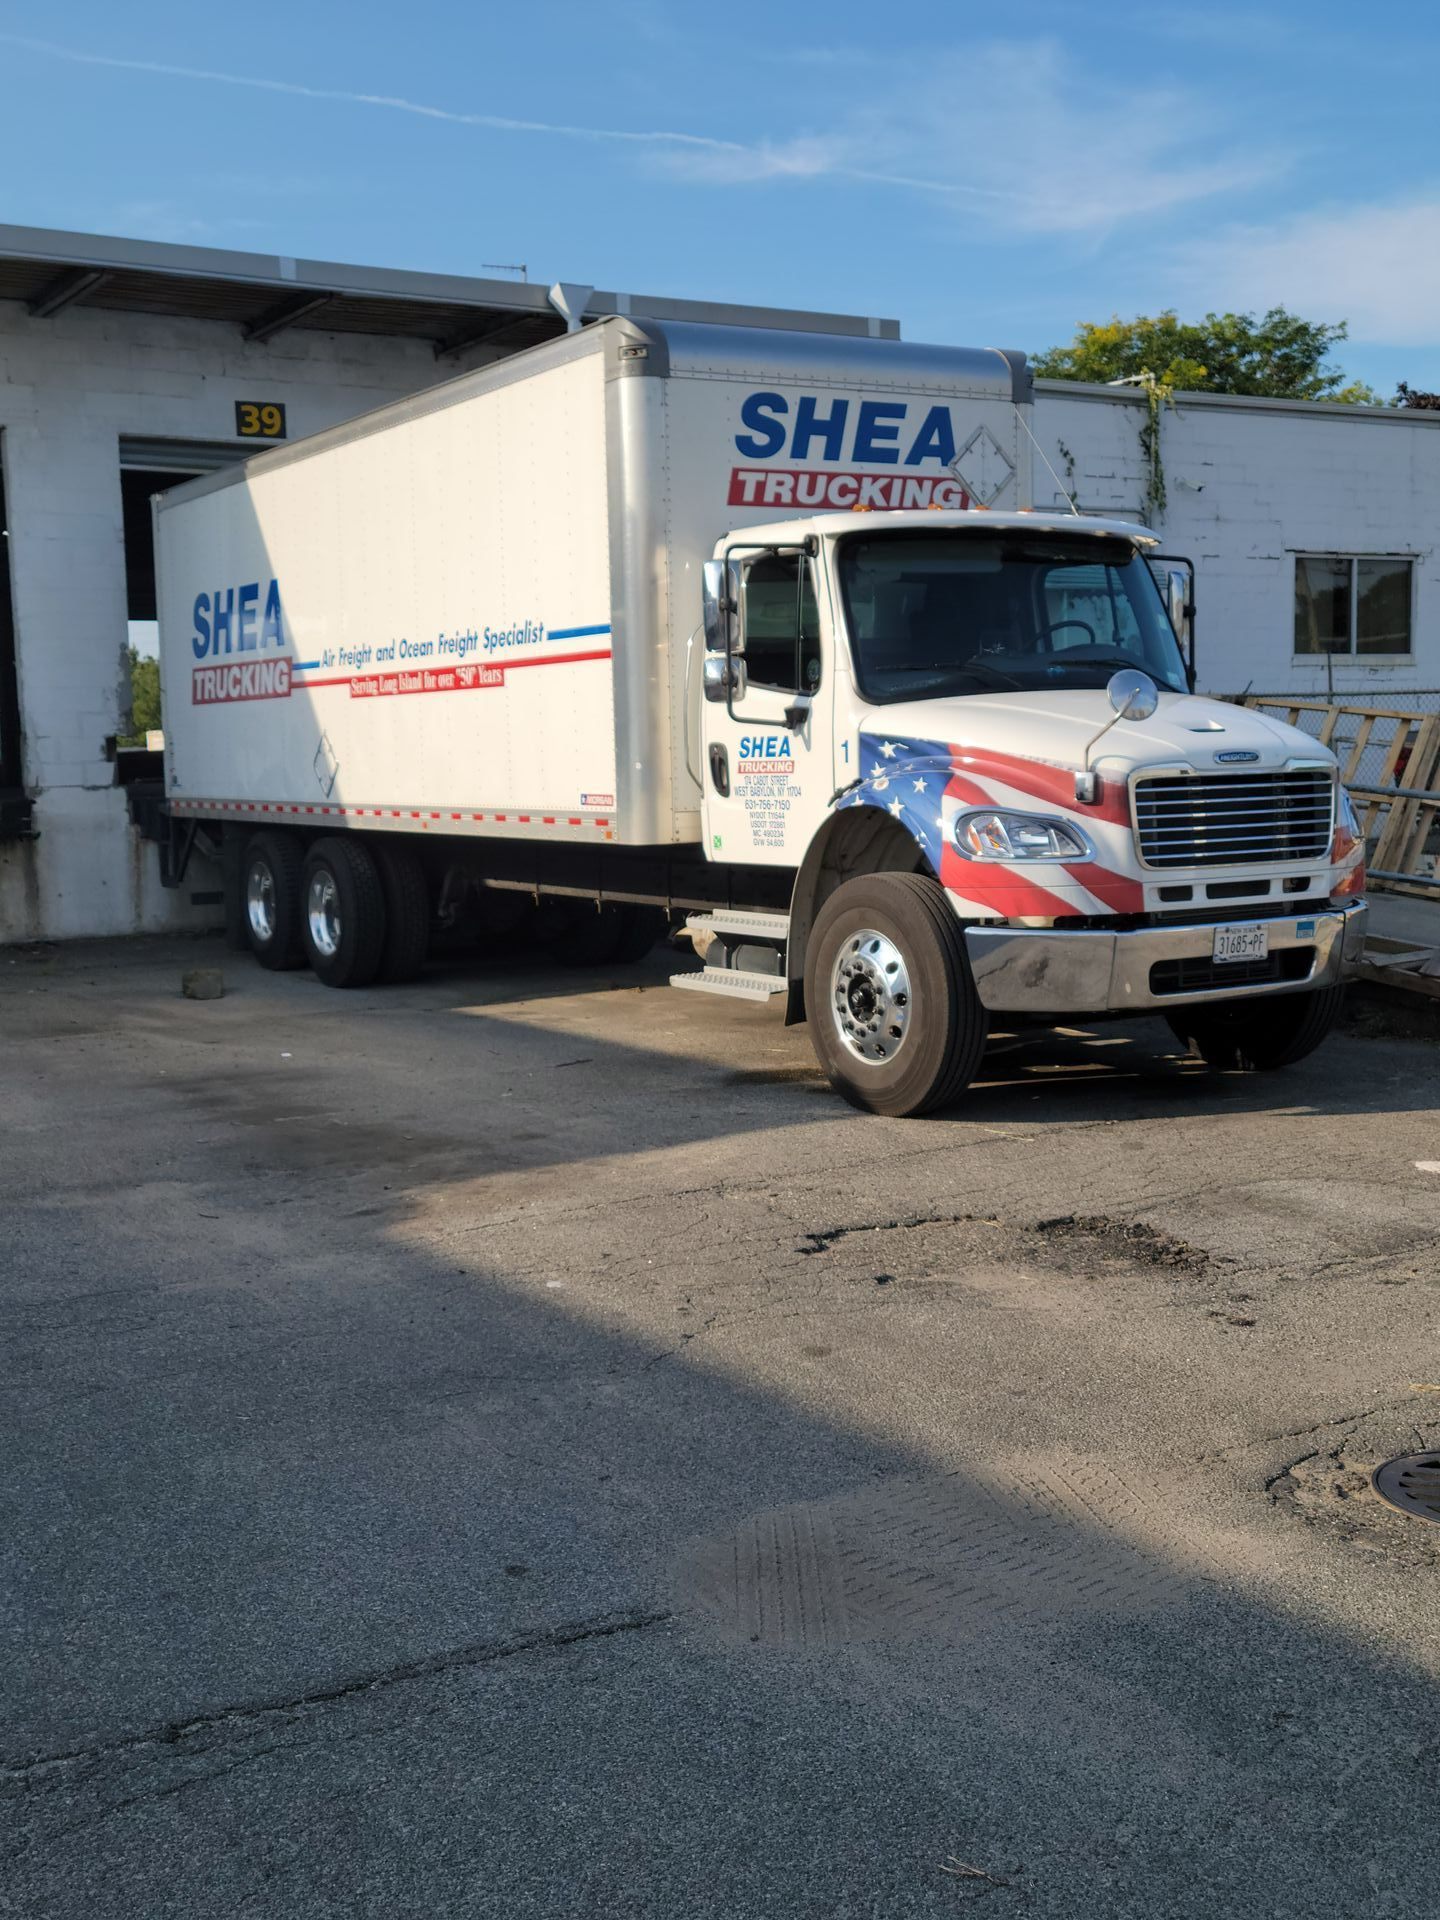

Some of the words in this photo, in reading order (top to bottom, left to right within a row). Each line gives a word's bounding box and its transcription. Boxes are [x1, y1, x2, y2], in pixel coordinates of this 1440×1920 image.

[241, 405, 281, 435] 39
[735, 392, 956, 467] SHEA
[737, 471, 961, 509] TRUCKING
[192, 579, 285, 659] SHEA
[322, 649, 336, 668] Air
[339, 644, 372, 670] Freight
[376, 641, 396, 661] and
[399, 639, 434, 658] Ocean
[438, 631, 478, 658] Freight
[483, 620, 544, 651] Specialist
[194, 660, 290, 701] TRUCKING
[351, 677, 379, 695] Serving
[379, 675, 399, 694] Long
[400, 670, 423, 690] Island
[424, 668, 437, 688] for
[438, 671, 456, 687] over
[478, 664, 502, 683] Years
[738, 735, 791, 758] SHEA
[841, 740, 849, 763] 1
[739, 761, 793, 773] TRUCKING
[753, 775, 769, 786] CABOT
[771, 775, 789, 786] STREET
[735, 786, 748, 796] WEST
[777, 786, 785, 796] NY
[787, 786, 801, 796] 11704
[745, 800, 790, 810] 631-756-7150
